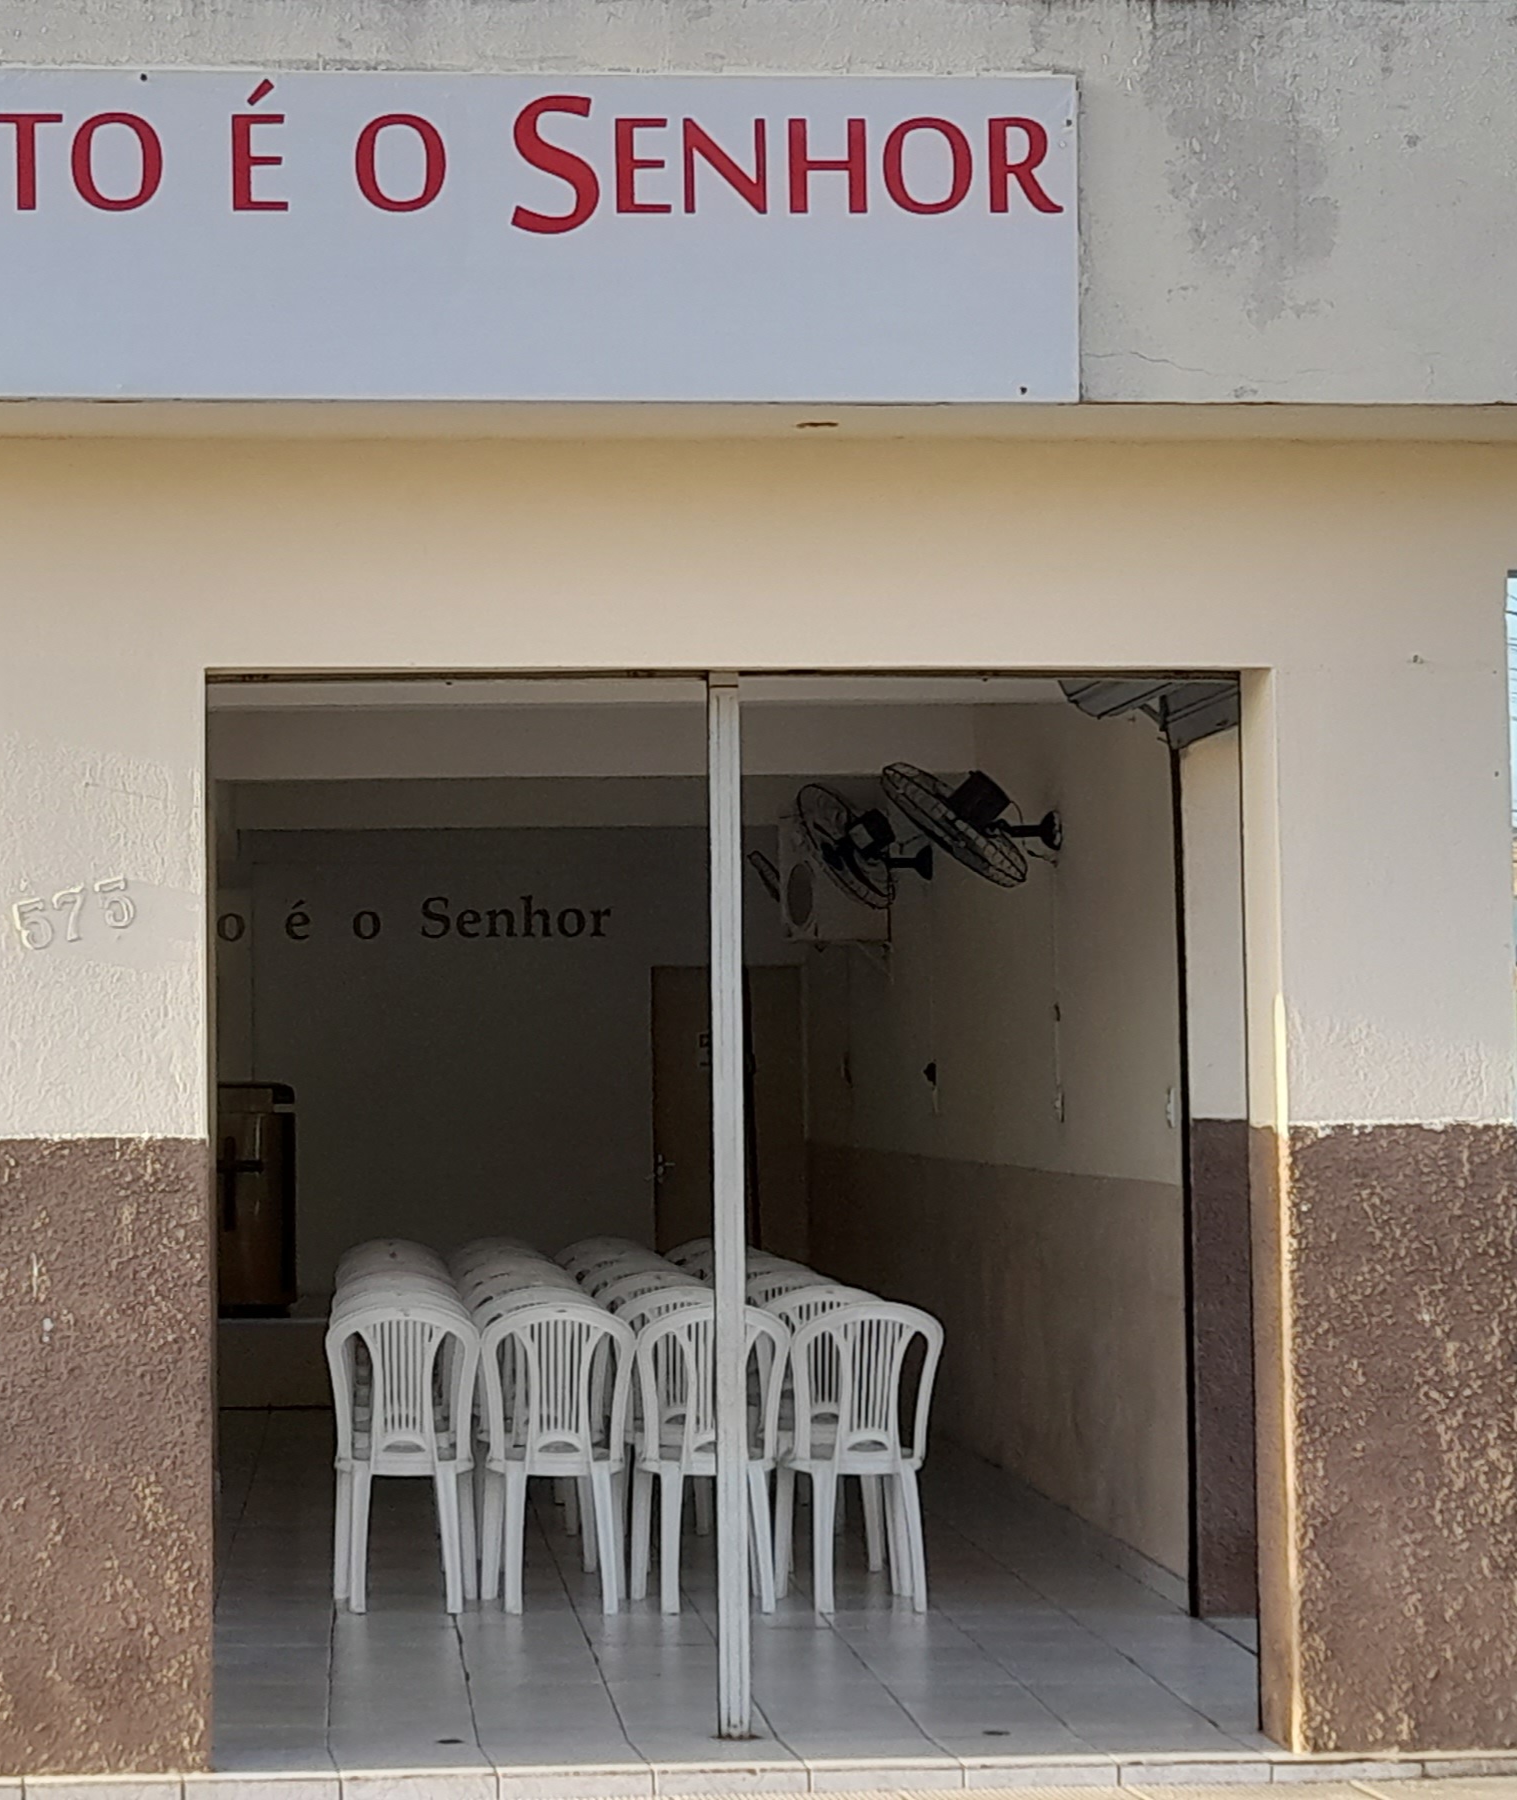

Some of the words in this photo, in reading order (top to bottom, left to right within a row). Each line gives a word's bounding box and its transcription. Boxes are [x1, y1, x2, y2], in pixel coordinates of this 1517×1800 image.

[231, 79, 289, 212] É
[355, 113, 447, 212] O
[511, 94, 1063, 234] SENHOR
[11, 874, 136, 950] 575
[285, 899, 311, 941] é
[352, 909, 382, 942] o
[420, 894, 613, 941] Senhor
